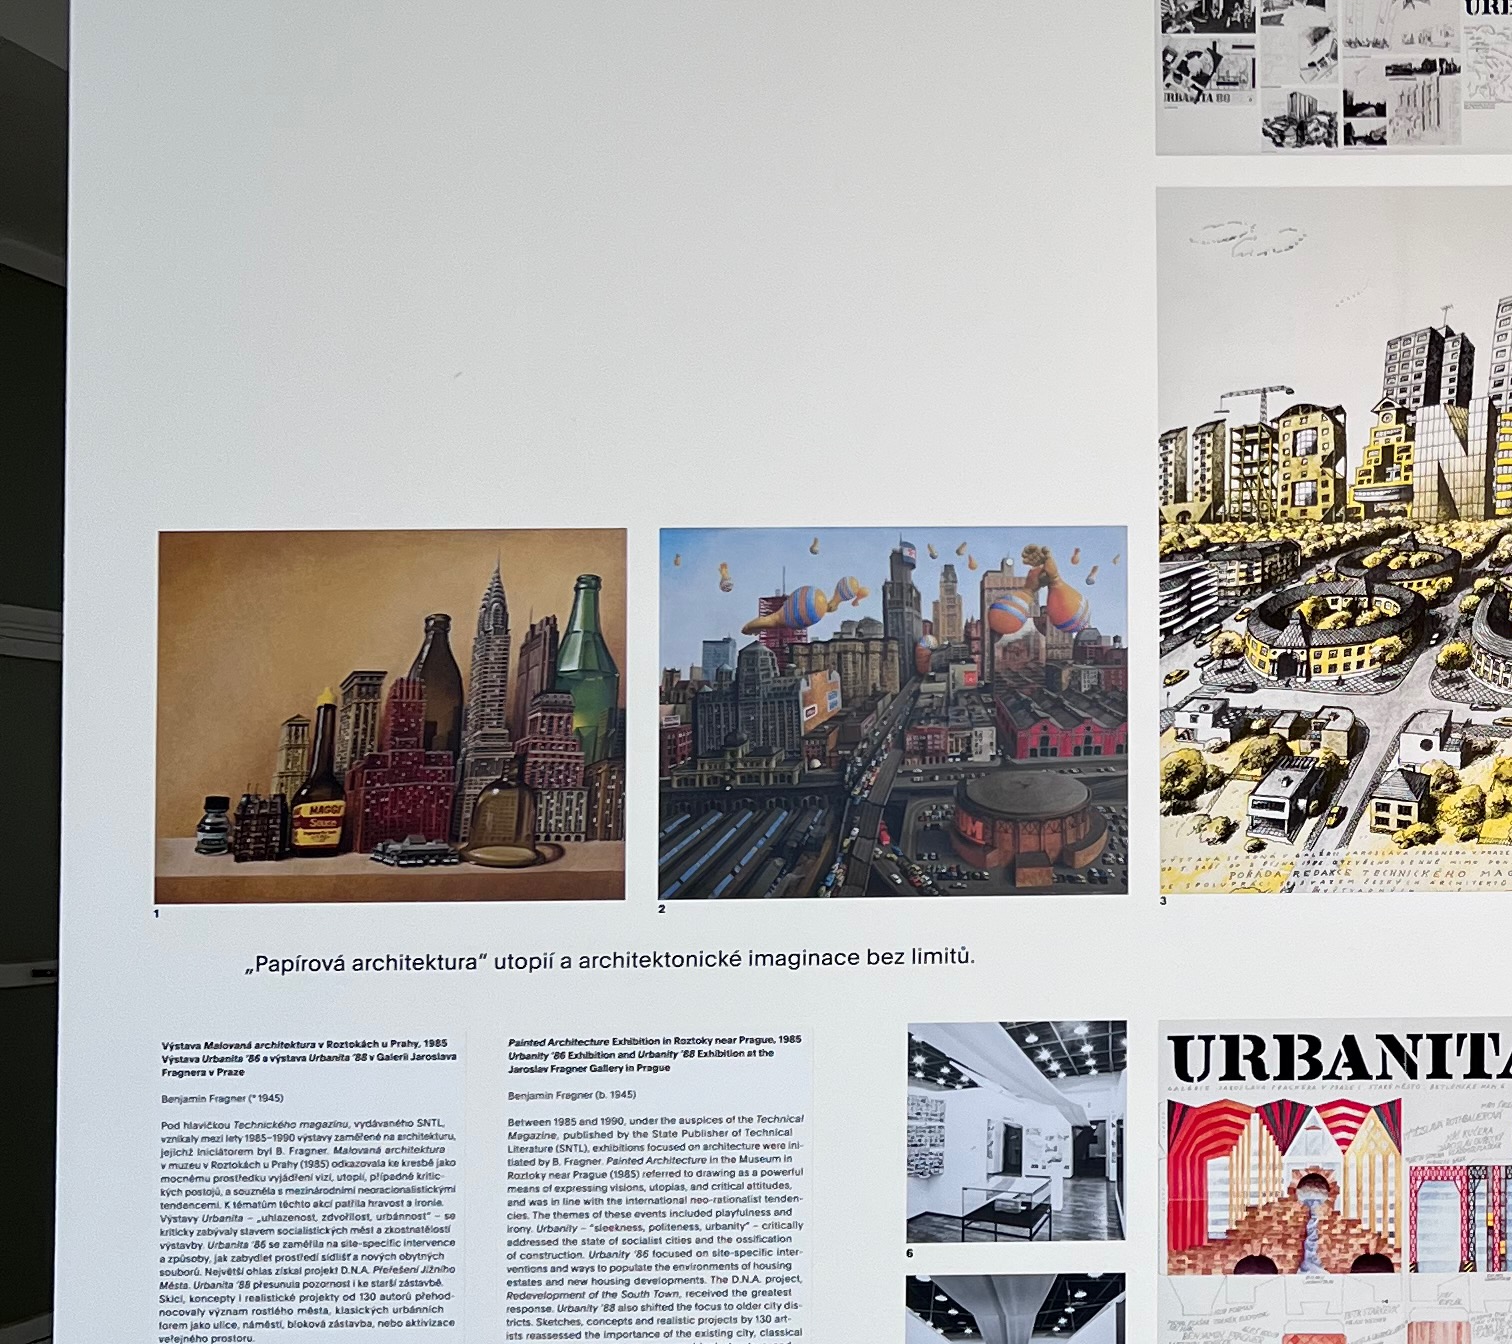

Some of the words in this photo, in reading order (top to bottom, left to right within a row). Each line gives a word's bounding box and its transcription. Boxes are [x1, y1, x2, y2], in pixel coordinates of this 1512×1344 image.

[310, 806, 342, 815] MAGGI
[1293, 869, 1352, 877] REDAKCE
[1160, 897, 1166, 905] 3
[659, 905, 665, 913] 2
[154, 910, 158, 918] 1
[494, 952, 555, 973] utopií
[560, 956, 571, 968] a
[579, 950, 741, 968] architektonické
[749, 948, 859, 970] imaginace
[867, 948, 904, 964] bez
[912, 946, 974, 964] limitů.
[161, 1042, 201, 1051] Výstava
[203, 1041, 252, 1049] Malovaná
[254, 1040, 316, 1049] architektura
[326, 1040, 379, 1048] Roztokách
[390, 1039, 421, 1048] Prahy,
[423, 1039, 447, 1047] 1985
[507, 1038, 546, 1046] Painted
[547, 1038, 609, 1046] Architecture
[612, 1037, 660, 1045] Exhibition
[662, 1036, 671, 1044] in
[674, 1036, 713, 1046] Roztoky
[739, 1035, 776, 1045] Prague,
[778, 1035, 801, 1043] 1985
[161, 1068, 206, 1078] Fragnera
[217, 1068, 245, 1076] Praze
[508, 1065, 548, 1073] Jaroslav
[550, 1064, 587, 1074] Fragner
[589, 1064, 623, 1073] Gallery
[636, 1063, 670, 1073] Prague
[508, 1091, 553, 1101] Benjamin
[556, 1090, 593, 1101] Fragner
[595, 1090, 607, 1099] (b.
[610, 1090, 636, 1099] 1945)
[907, 1249, 913, 1257] 6
